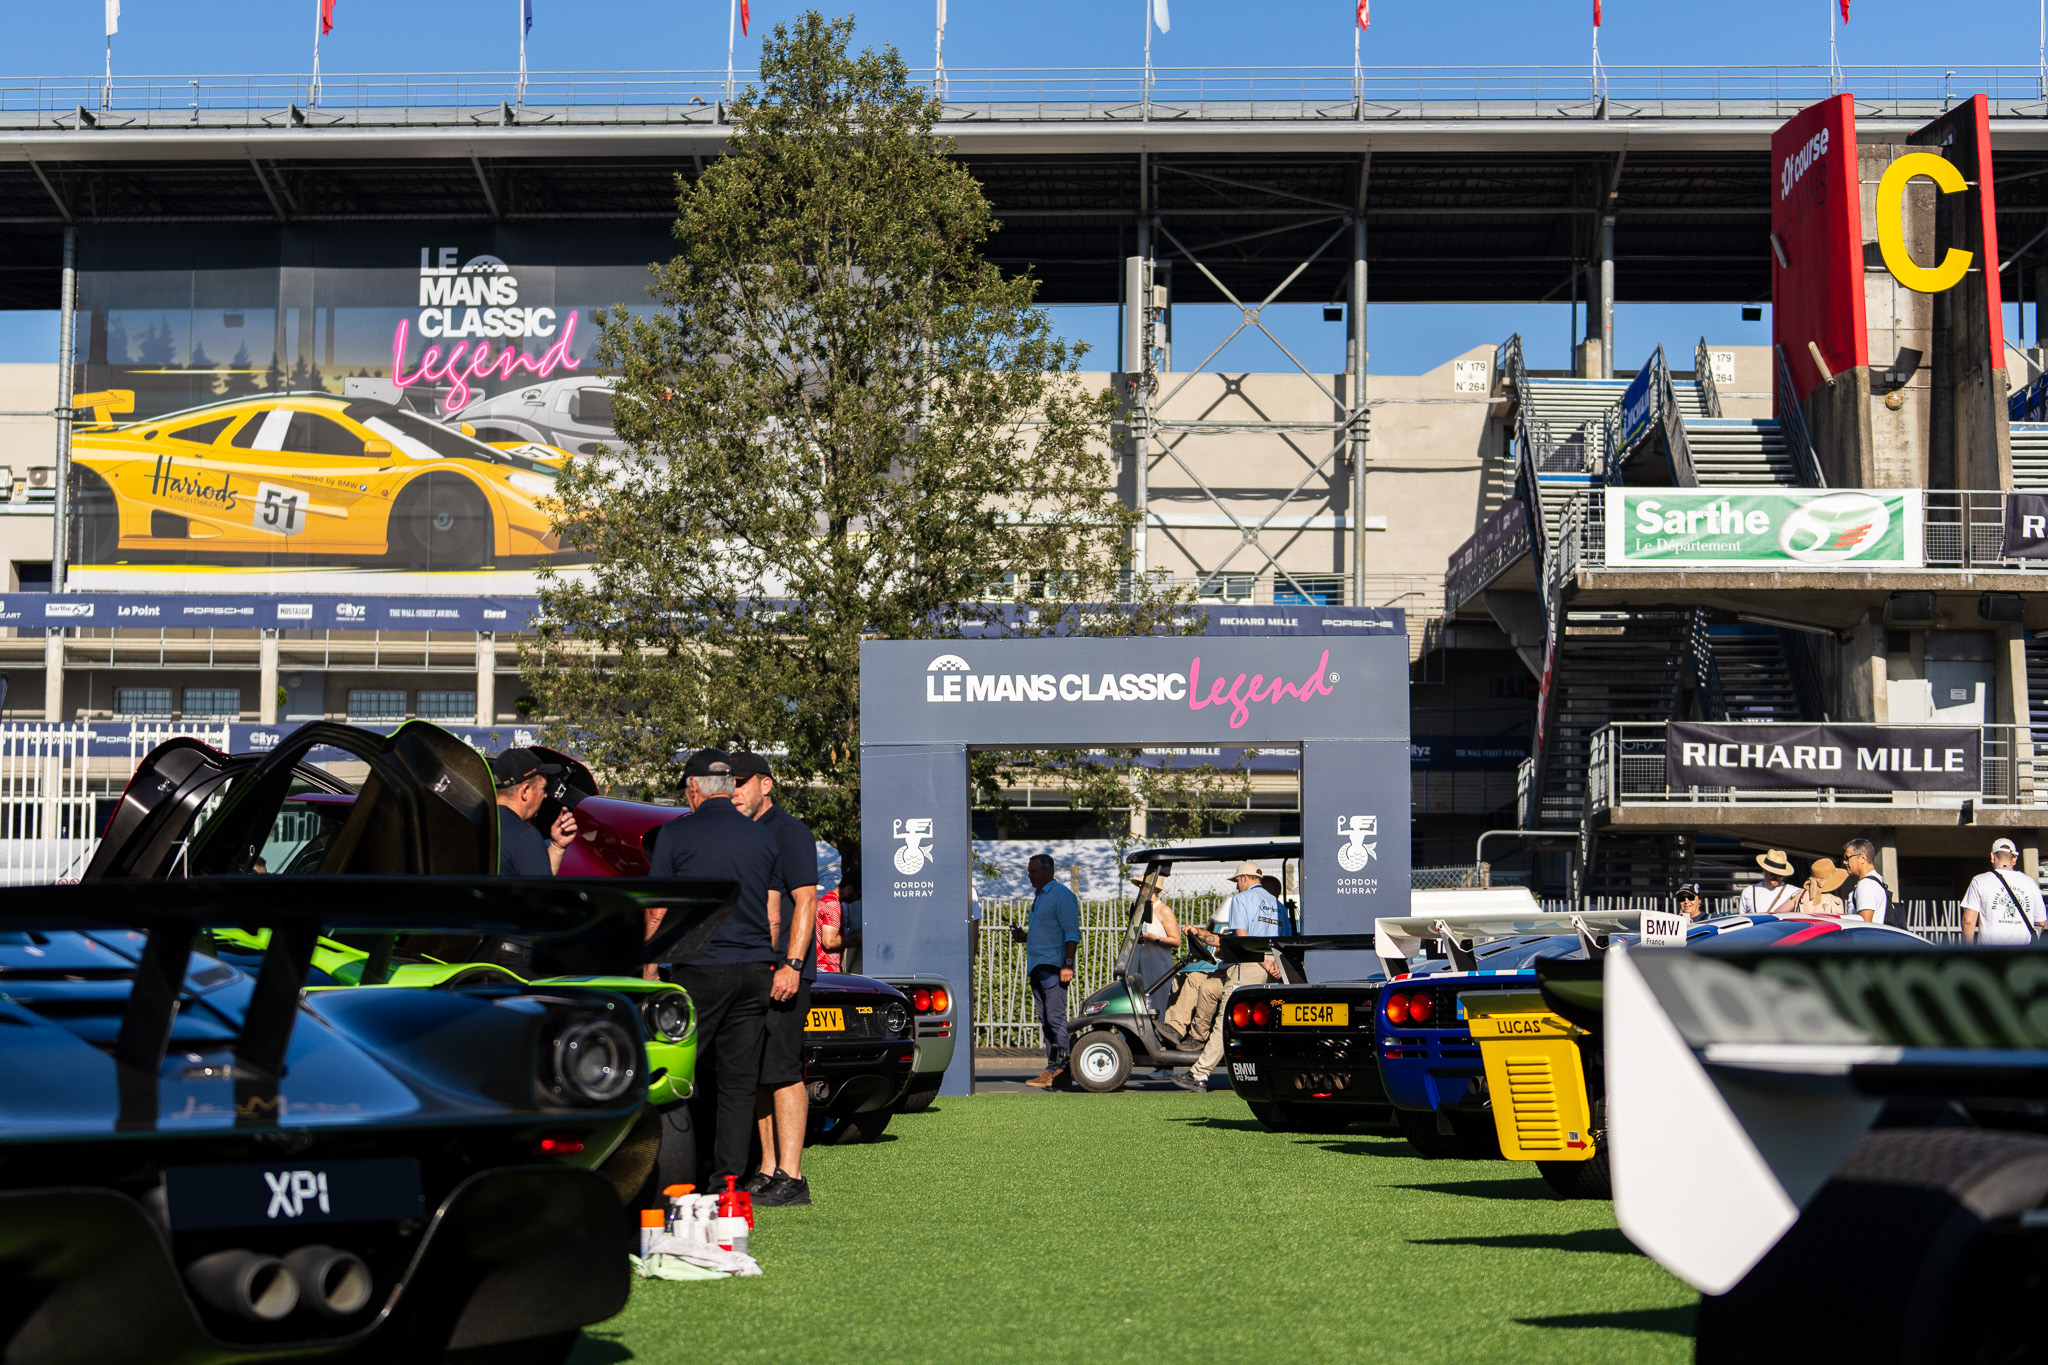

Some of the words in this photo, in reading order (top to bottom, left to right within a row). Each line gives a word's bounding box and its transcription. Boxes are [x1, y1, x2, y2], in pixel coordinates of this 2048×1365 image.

[1794, 128, 1829, 182] course
[1876, 152, 1974, 293] C
[420, 247, 458, 276] LE
[419, 276, 518, 306] MANS
[418, 307, 556, 338] CLASSIC
[393, 310, 581, 412] Legend
[1717, 354, 1732, 363] 179
[1471, 362, 1486, 371] 179
[1716, 374, 1732, 382] 264
[1469, 382, 1486, 391] 264
[144, 454, 239, 510] Harrods
[292, 473, 324, 483] powered
[326, 478, 335, 486] by
[338, 480, 358, 489] BMW
[263, 489, 297, 529] 51
[1635, 500, 1770, 534] Sarthe
[1635, 538, 1652, 551] Le
[1657, 538, 1741, 555] Département
[118, 606, 130, 616] Le
[132, 605, 160, 616] Point
[183, 607, 254, 615] PORSCHE
[336, 603, 366, 617] Cityz
[389, 609, 401, 617] THE
[401, 609, 415, 617] WALL
[416, 609, 436, 617] STREET
[1220, 618, 1265, 626] RICHARD
[1267, 618, 1298, 626] MILLE
[1321, 619, 1393, 628] PORSCHE
[926, 674, 962, 702] LE
[966, 673, 1057, 701] MANS
[1058, 673, 1187, 701] CLASSIC
[249, 732, 280, 744] Cityz
[1455, 749, 1466, 757] THE
[1482, 749, 1502, 757] STREET
[1682, 742, 1843, 770] RICHARD
[1856, 747, 1965, 772] MILLE
[893, 881, 934, 889] GORDON
[1337, 878, 1378, 886] GORDON
[893, 890, 934, 898] MURRAY
[1646, 919, 1680, 936] BMW
[1646, 937, 1665, 946] France
[812, 1010, 837, 1028] BYV
[1497, 1020, 1541, 1034] LUCAS
[1232, 1062, 1256, 1076] BMW
